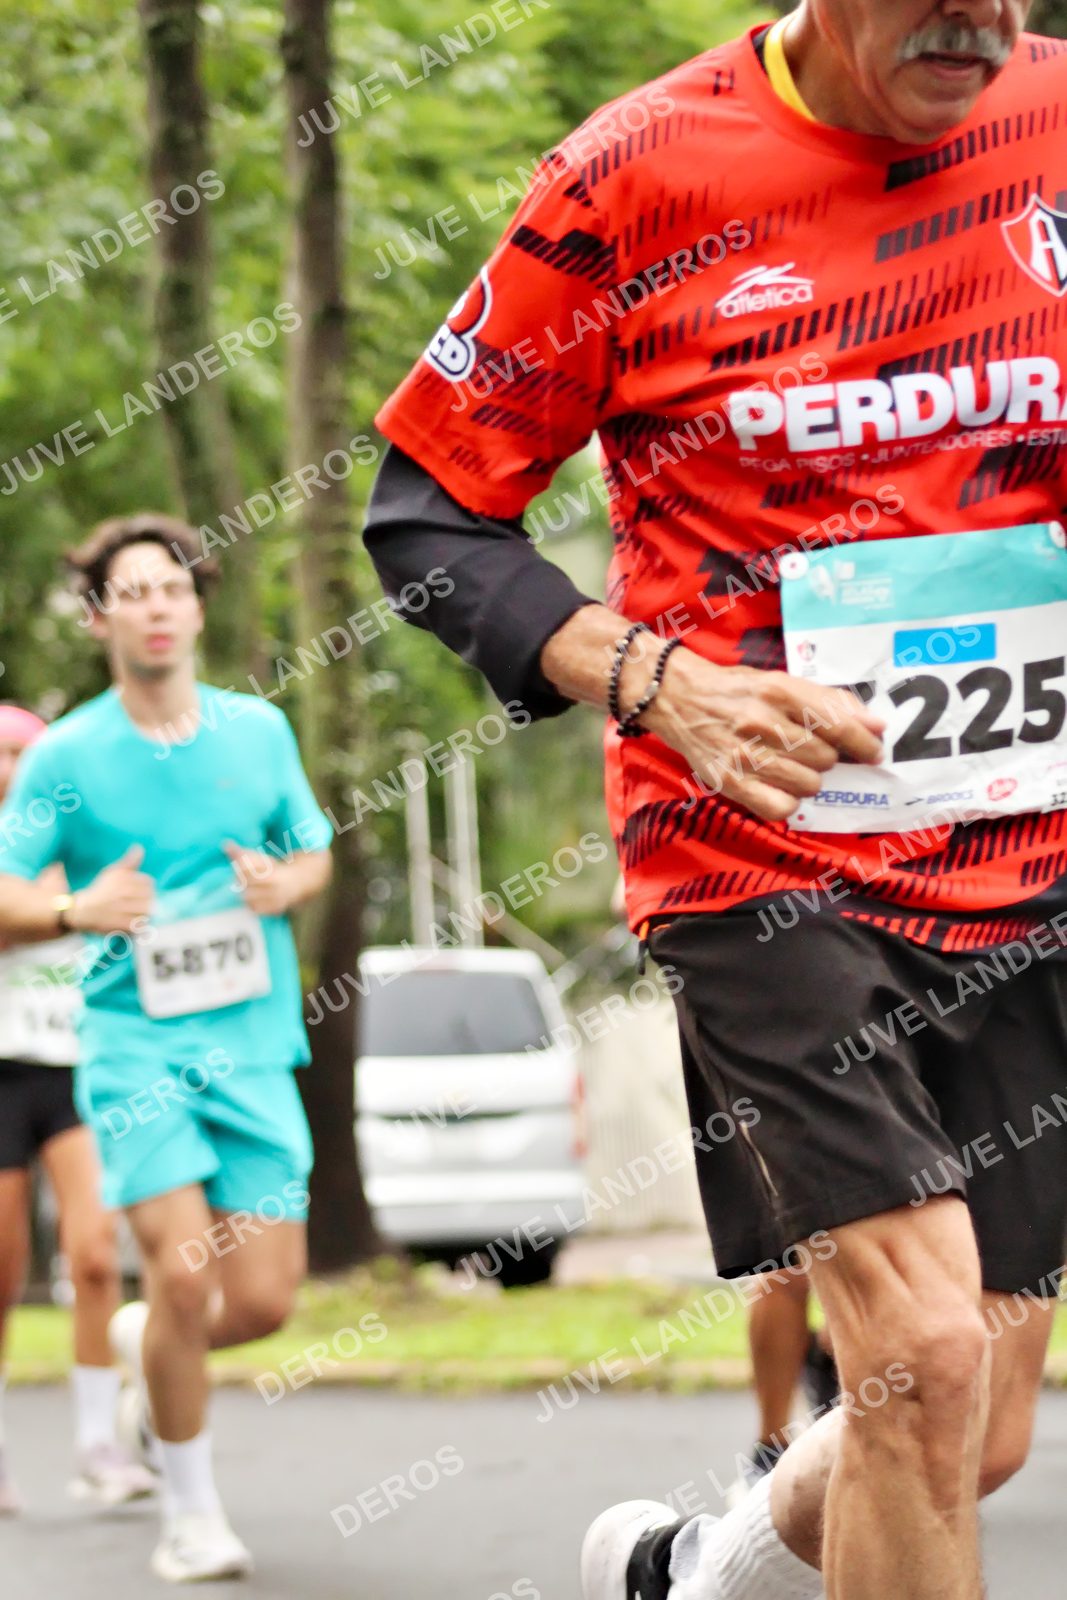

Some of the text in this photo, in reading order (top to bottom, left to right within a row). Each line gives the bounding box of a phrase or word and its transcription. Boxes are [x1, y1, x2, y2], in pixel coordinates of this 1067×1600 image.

[729, 356, 1067, 452] PERDUR
[824, 656, 1067, 763] 225
[814, 790, 889, 807] PERDURA
